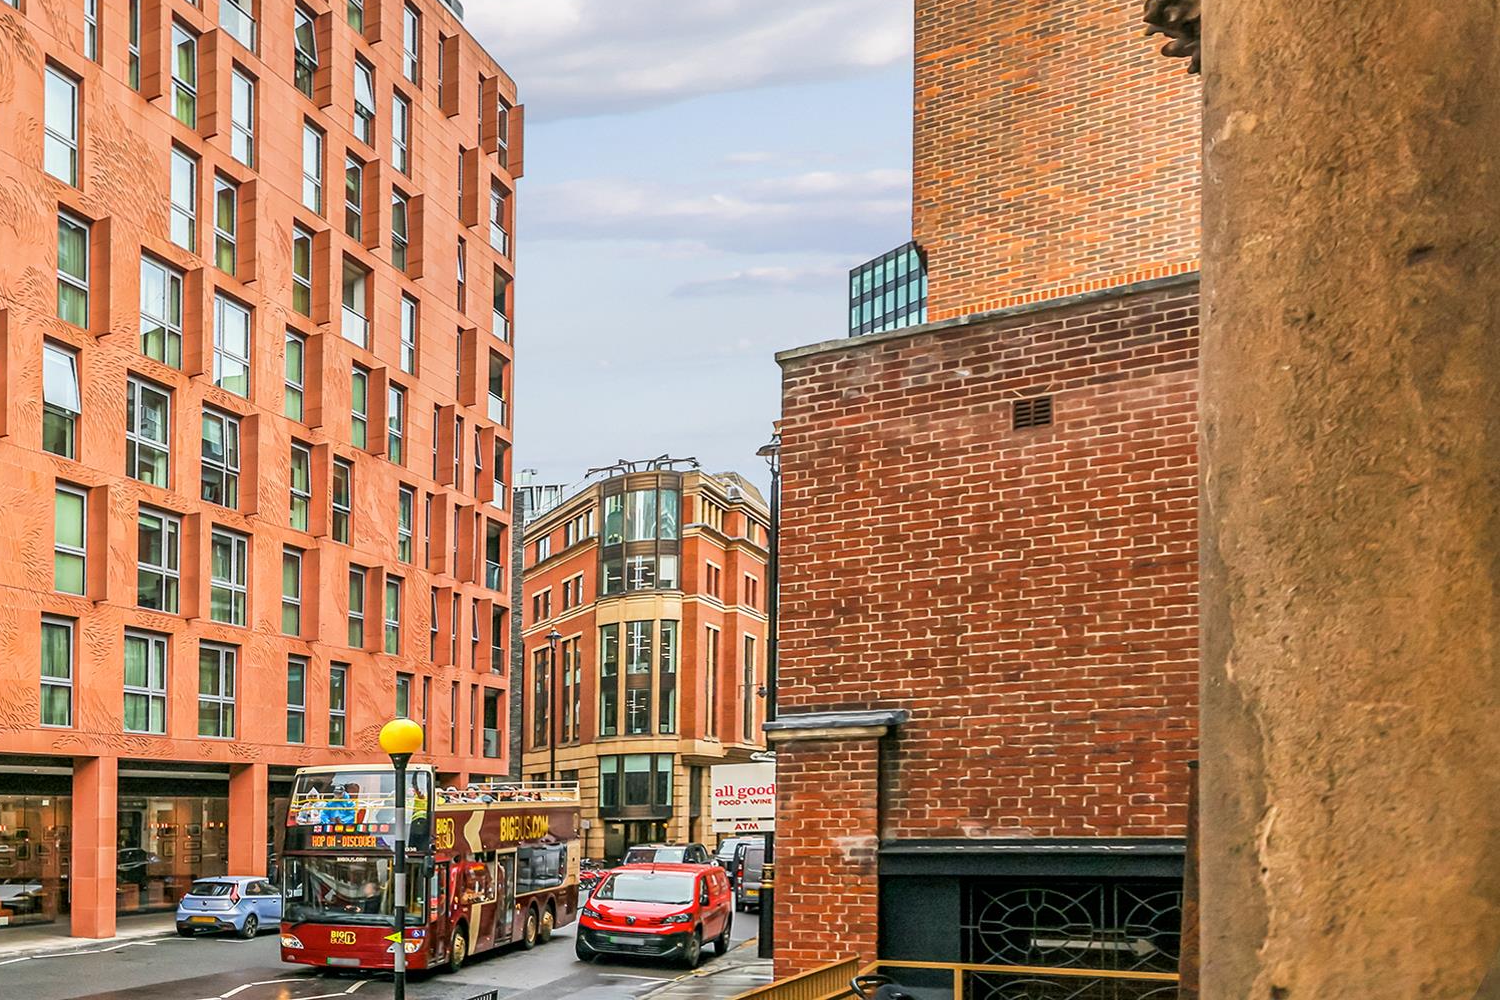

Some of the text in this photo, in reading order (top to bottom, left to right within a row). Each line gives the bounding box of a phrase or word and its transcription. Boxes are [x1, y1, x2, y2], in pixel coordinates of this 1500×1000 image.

[715, 784, 776, 799] all good
[500, 815, 549, 842] BIGBUS.COM
[312, 835, 325, 847] HOP
[342, 835, 377, 848] DISCOVER
